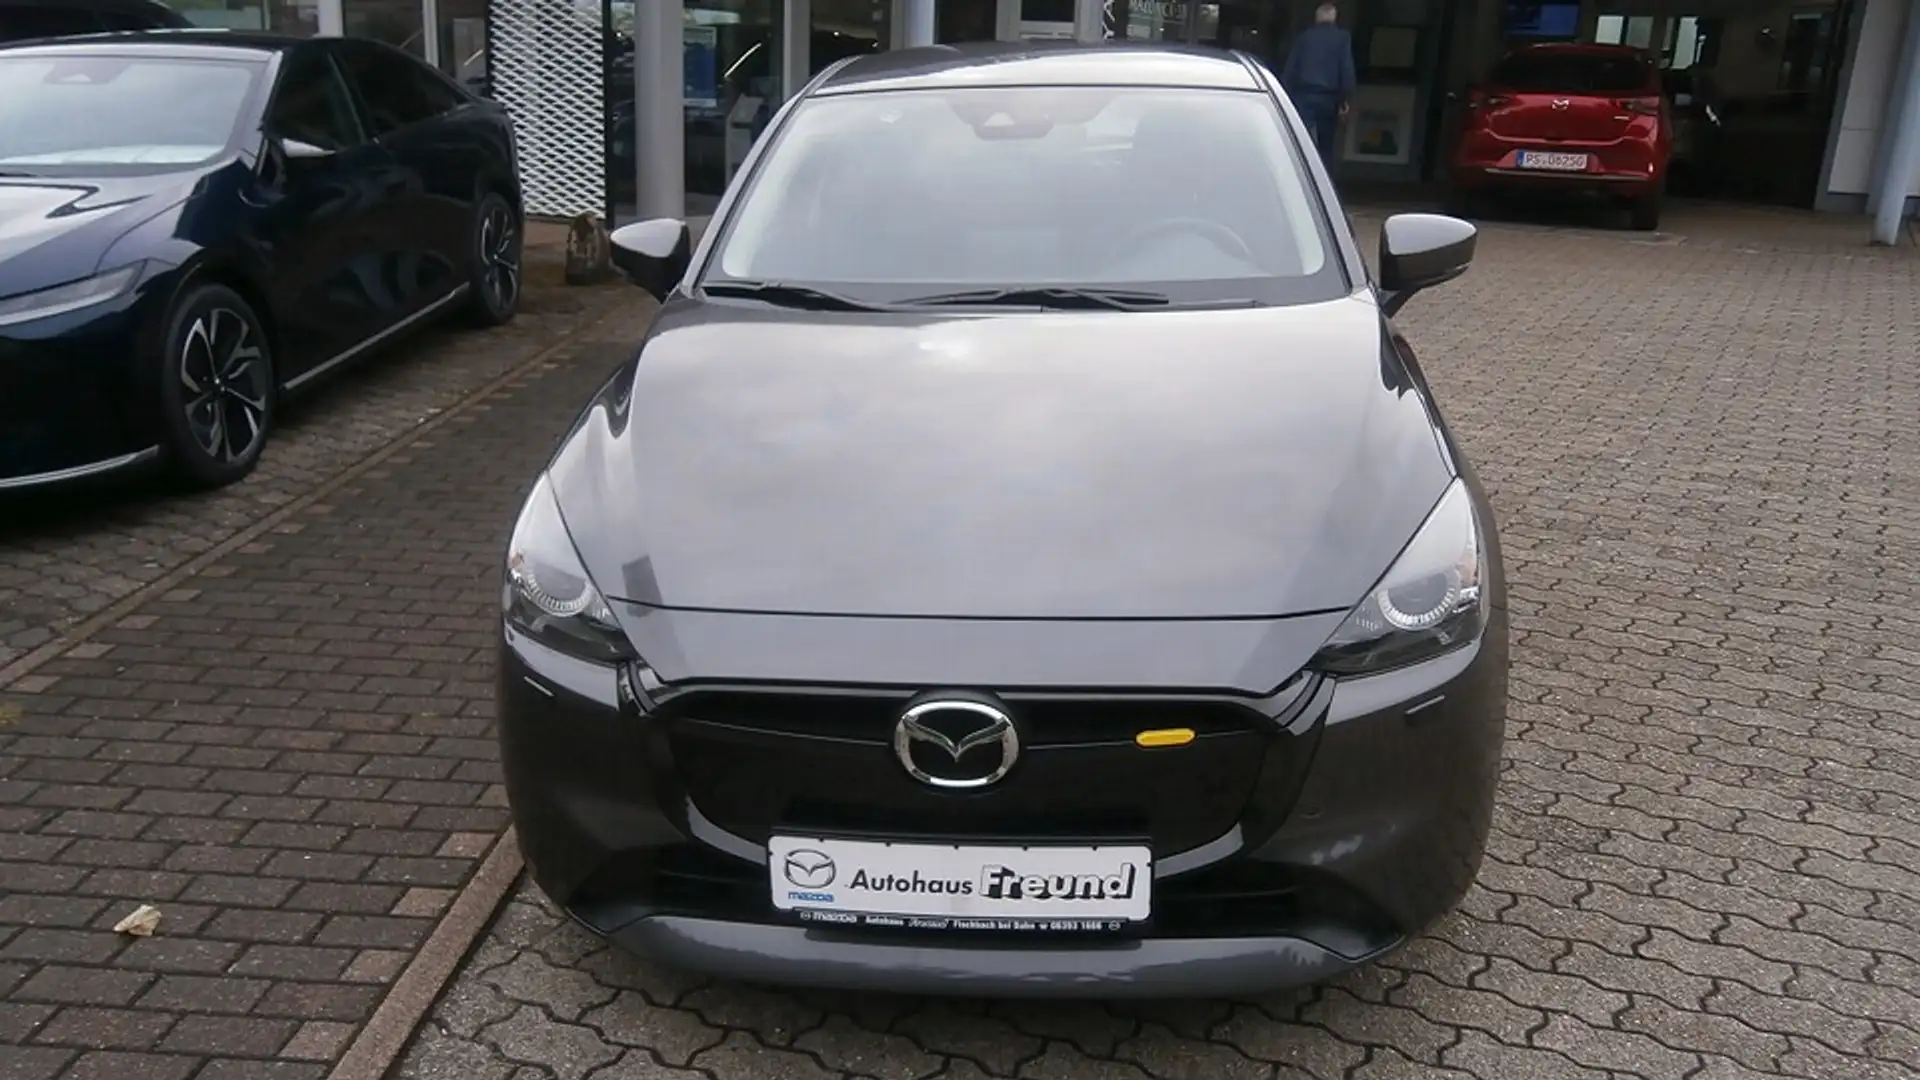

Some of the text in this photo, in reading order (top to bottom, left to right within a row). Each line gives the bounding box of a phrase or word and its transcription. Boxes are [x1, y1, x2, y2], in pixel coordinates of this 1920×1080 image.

[849, 862, 1137, 900] Autohaus Freund
[787, 891, 835, 903] mazda
